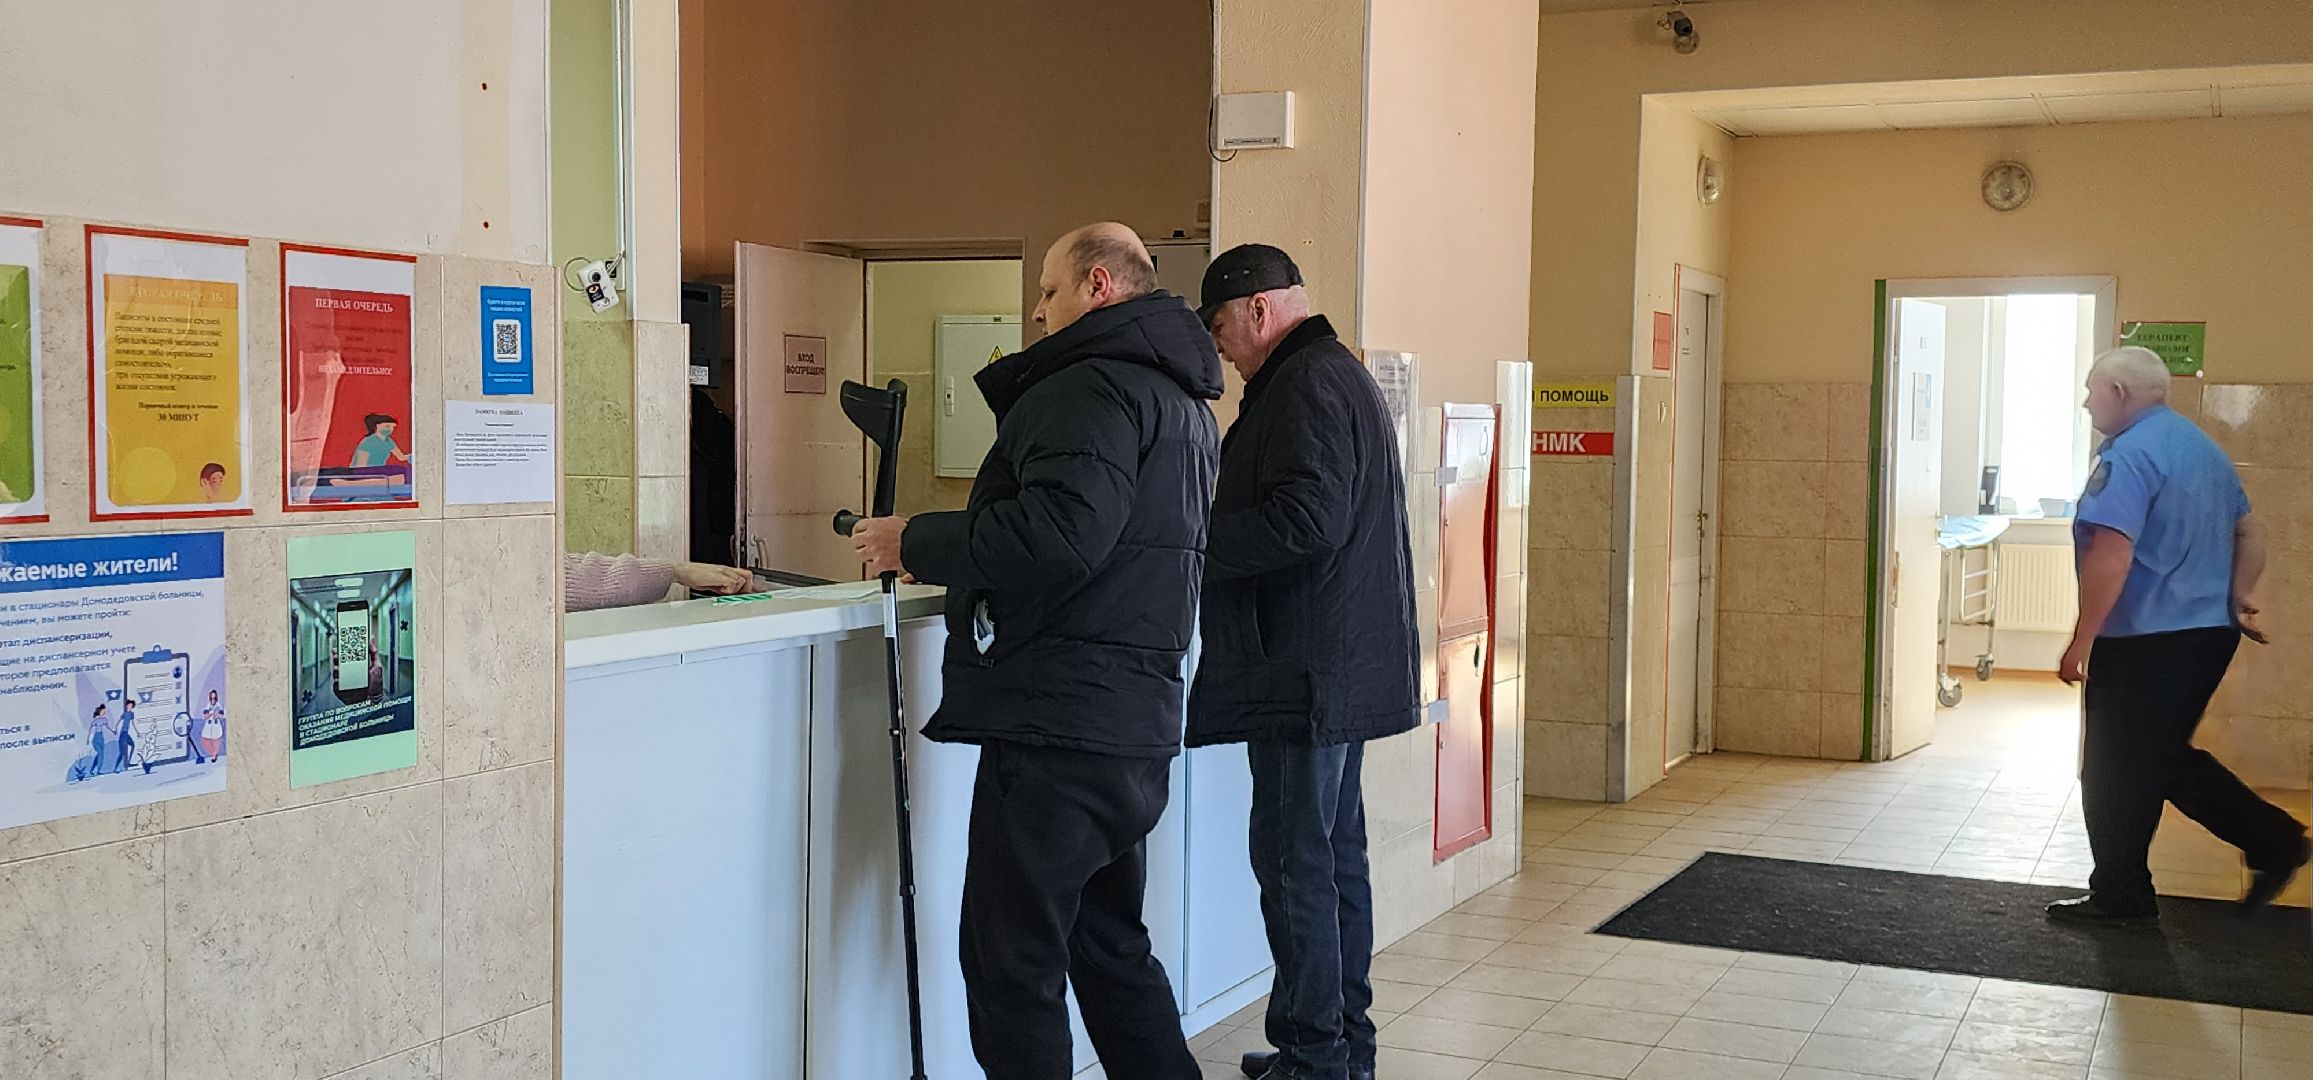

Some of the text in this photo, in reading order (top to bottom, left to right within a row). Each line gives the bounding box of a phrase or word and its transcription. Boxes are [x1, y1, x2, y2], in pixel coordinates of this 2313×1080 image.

[315, 298, 394, 313] ПЕРВАЯ ОЧЕРЕДЬ
[1540, 390, 1609, 404] ПОМОЩЬ
[1532, 432, 1586, 453] НМК
[0, 551, 178, 582] жаемые жители!
[81, 592, 156, 607] Домодедовской
[158, 590, 204, 600] больницы,
[57, 612, 93, 622] можете
[22, 631, 113, 647] диспансеризации,
[110, 645, 136, 656] учете
[32, 662, 112, 678] предполагается
[32, 733, 76, 745] выписки
